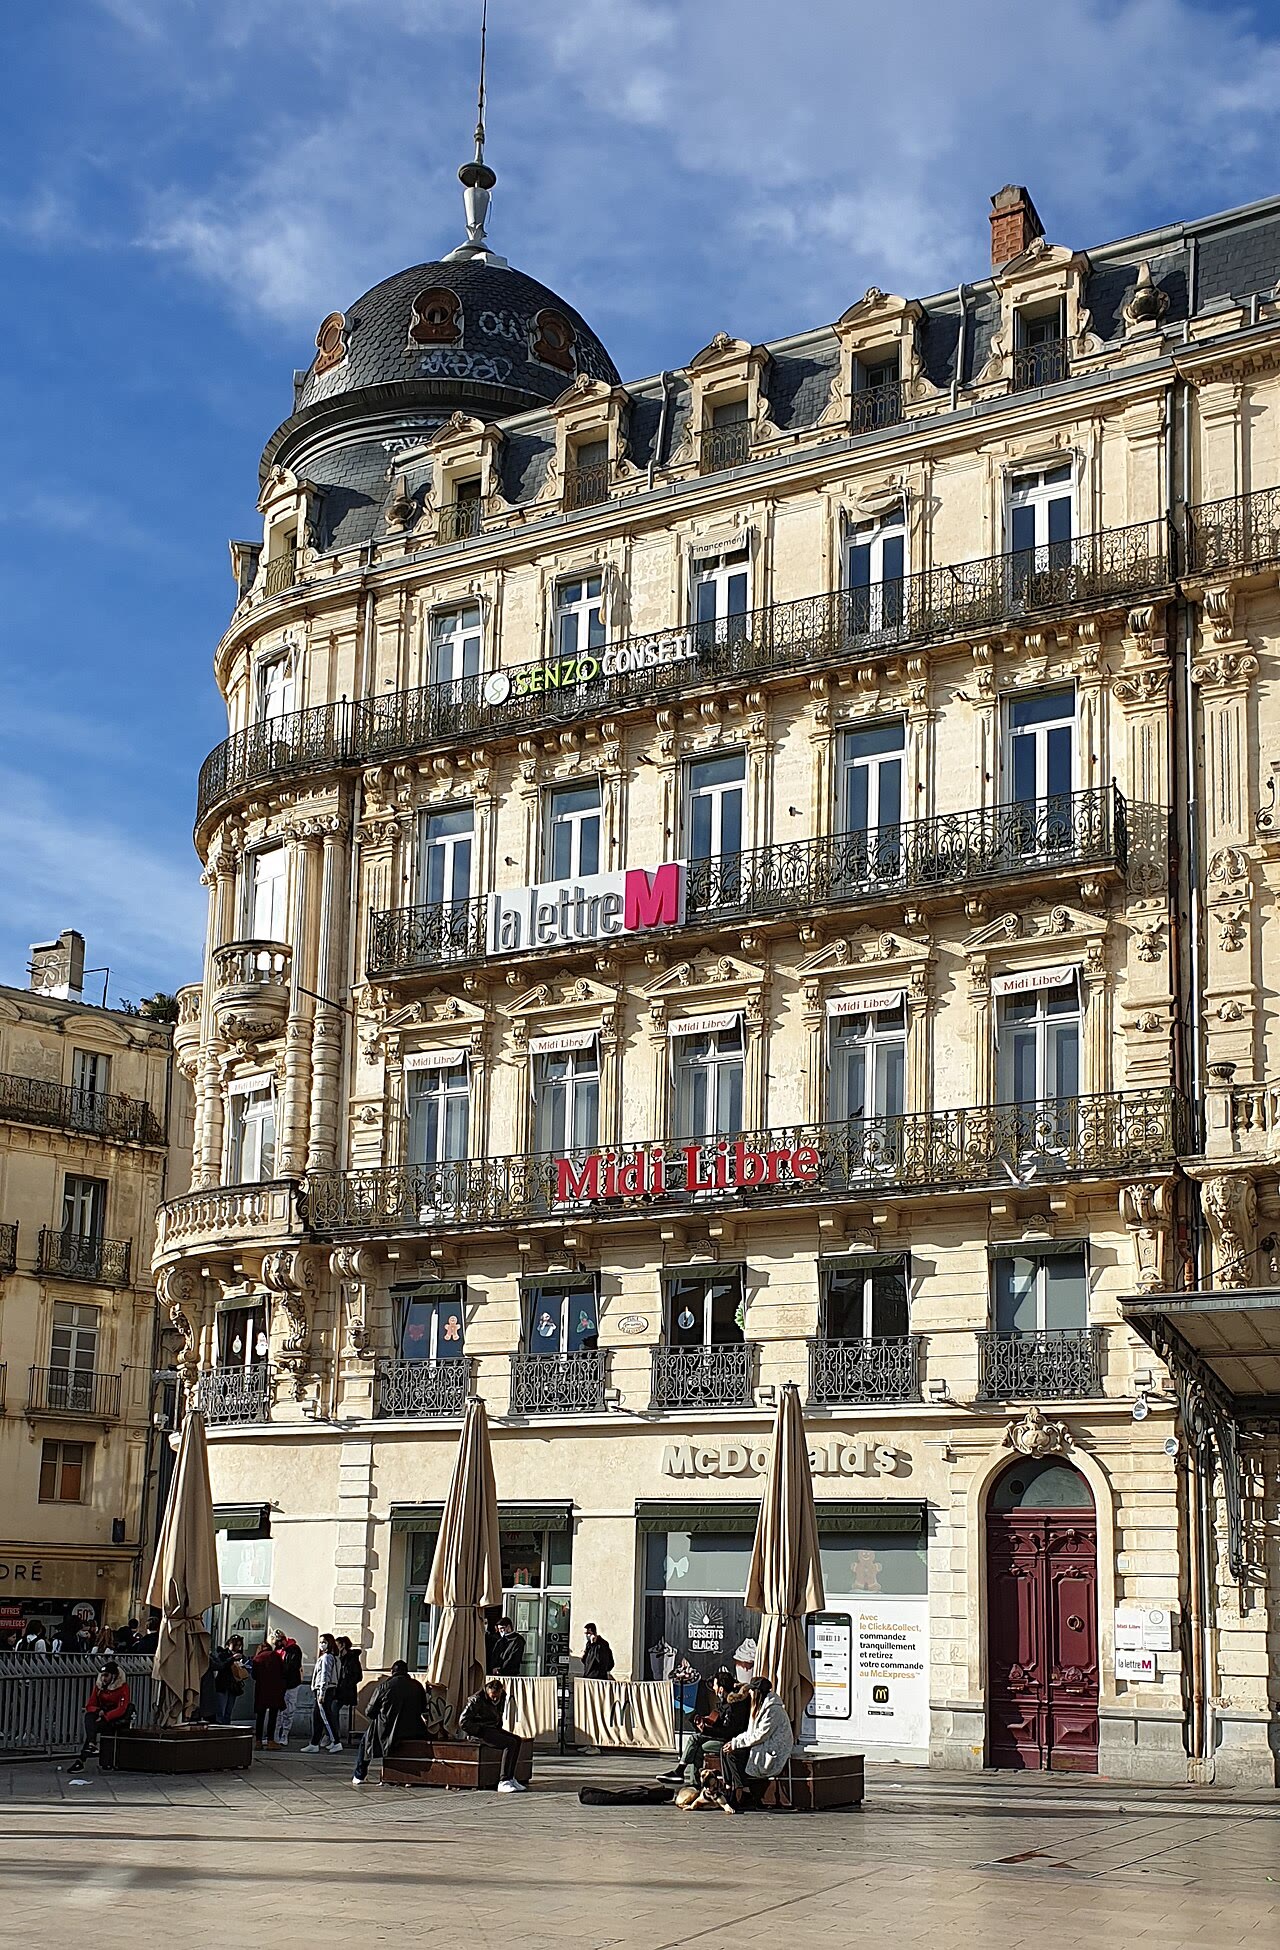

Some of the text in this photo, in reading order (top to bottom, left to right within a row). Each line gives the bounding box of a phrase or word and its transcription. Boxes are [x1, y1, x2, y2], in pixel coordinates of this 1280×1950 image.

[516, 657, 599, 696] SENZO
[602, 634, 698, 676] CONSEIL
[491, 863, 679, 952] la lettre M
[1004, 975, 1061, 991] Midi Libre
[837, 999, 890, 1012] Midi Libre
[678, 1019, 726, 1032] Midi Libre
[538, 1038, 584, 1051] Midi Libre
[412, 1056, 455, 1067] Midi Libre
[554, 1140, 820, 1202] Midi Libre
[661, 1441, 898, 1475] McDoald's
[860, 1613, 878, 1621] Avec
[860, 1622, 867, 1630] le
[688, 1628, 724, 1639] DESSERTS
[860, 1633, 906, 1641] commandez
[692, 1638, 719, 1650] GLACÉS
[860, 1642, 916, 1651] tranquillement
[860, 1651, 893, 1659] et retirez
[860, 1661, 924, 1670] votre commande
[1118, 1659, 1152, 1669] la lettre M
